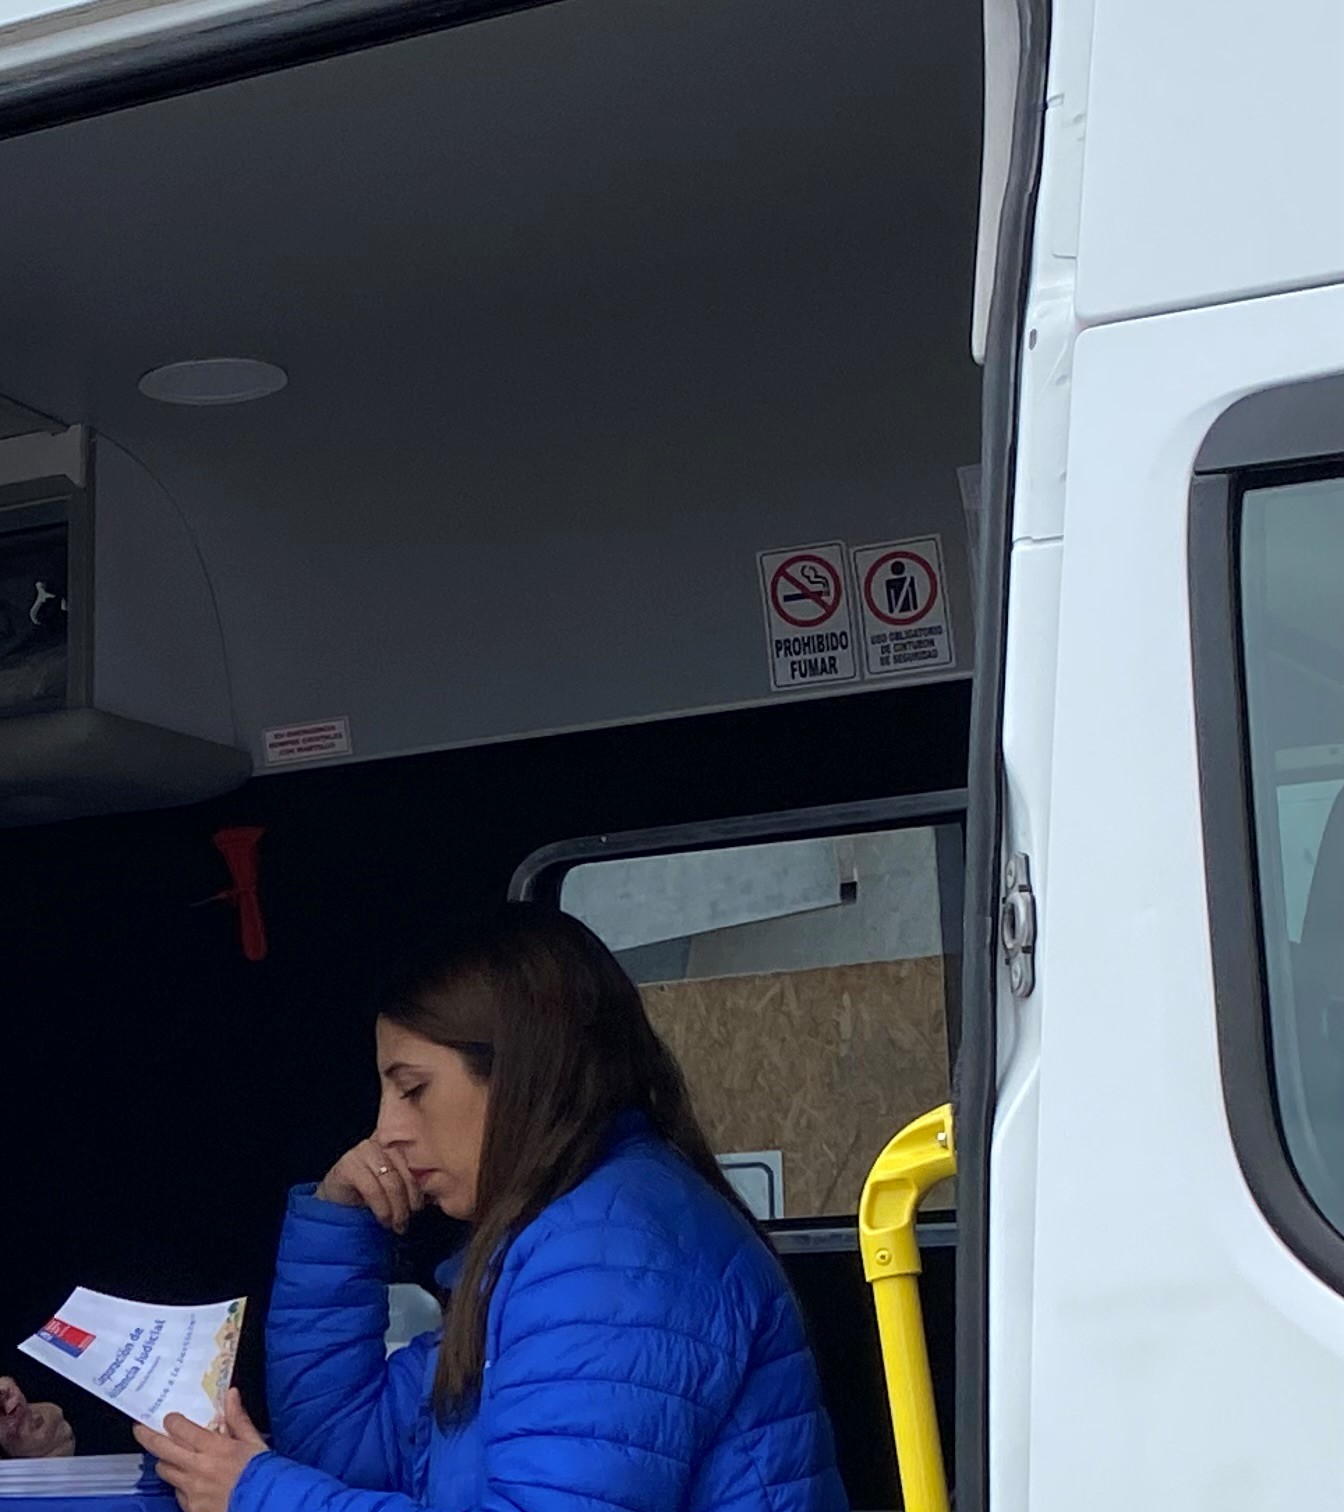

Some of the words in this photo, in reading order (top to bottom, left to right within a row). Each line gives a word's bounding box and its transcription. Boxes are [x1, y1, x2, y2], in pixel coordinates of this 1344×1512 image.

[775, 631, 849, 658] PROHIBIDO
[790, 656, 839, 680] FUMAR
[129, 1326, 144, 1343] de
[137, 1318, 167, 1365] Judicial
